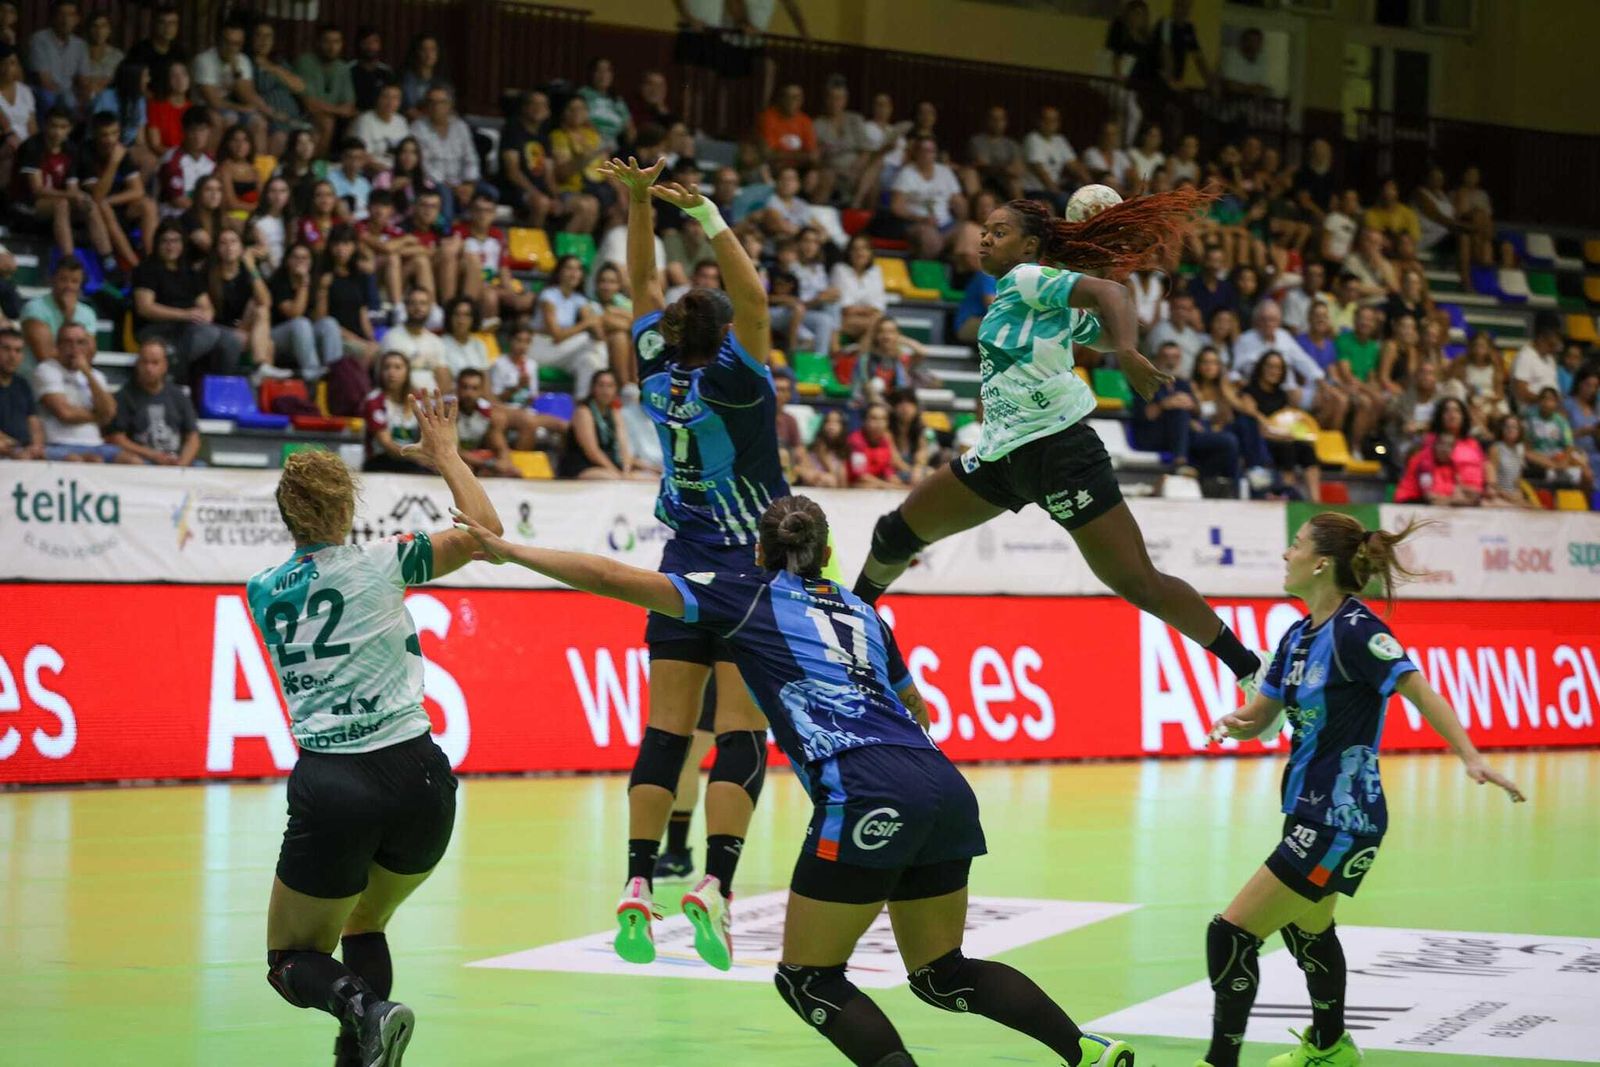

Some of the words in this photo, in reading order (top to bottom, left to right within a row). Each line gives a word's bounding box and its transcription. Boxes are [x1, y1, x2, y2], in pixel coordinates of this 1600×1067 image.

[11, 478, 121, 525] teika
[197, 506, 283, 523] COMUNITA
[265, 588, 350, 668] 22
[805, 607, 872, 671] 17
[205, 594, 471, 772] AS
[862, 820, 904, 837] CSIF
[1291, 823, 1318, 849] 10
